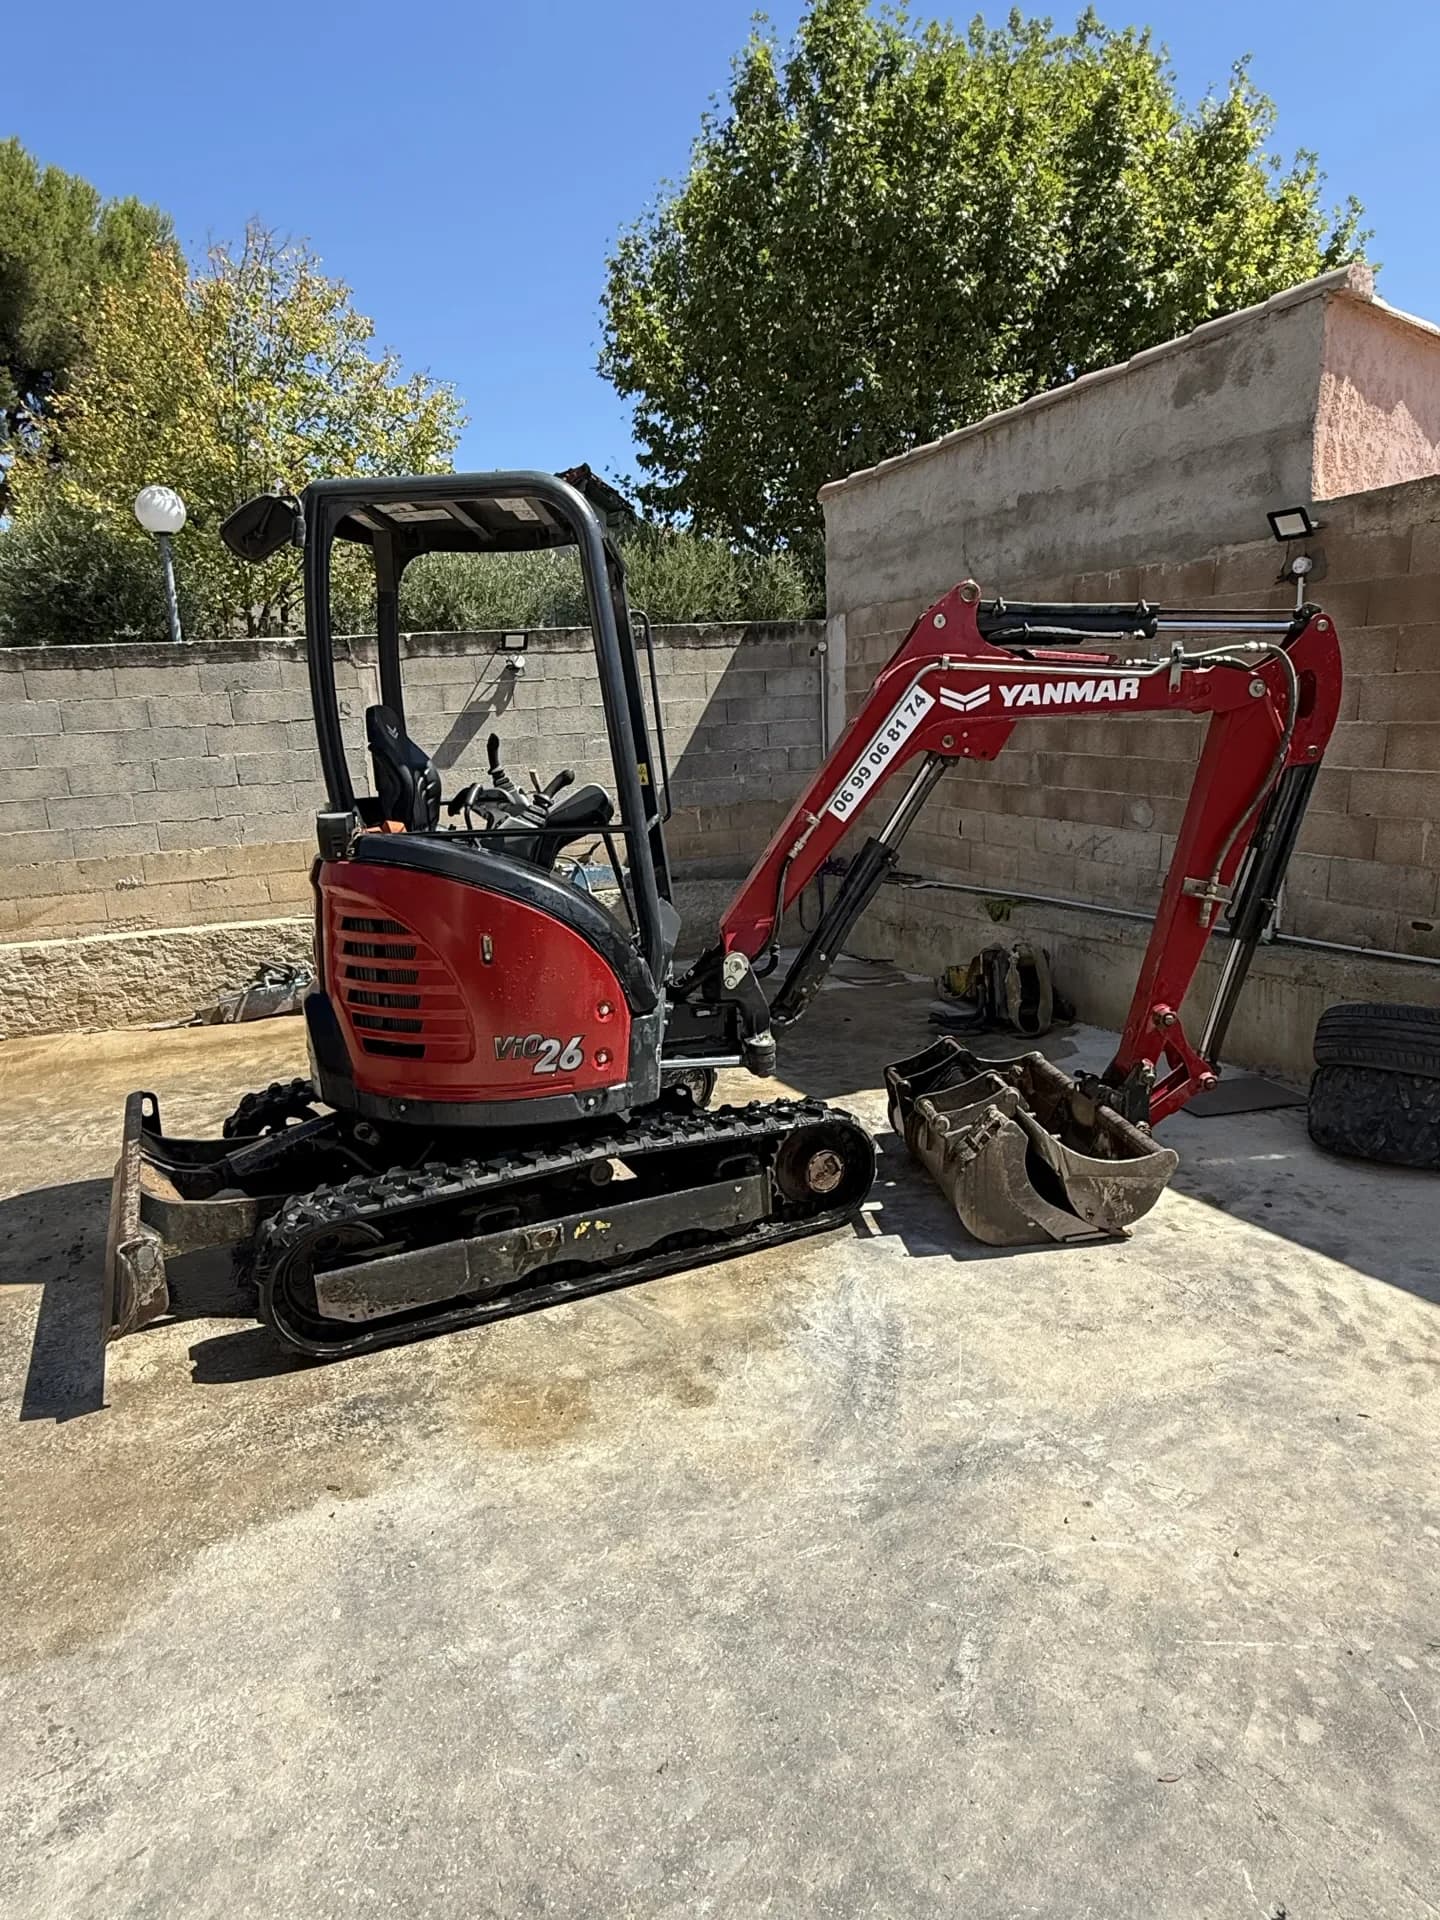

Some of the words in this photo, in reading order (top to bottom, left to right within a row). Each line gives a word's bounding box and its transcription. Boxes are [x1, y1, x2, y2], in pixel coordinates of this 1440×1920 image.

[998, 677, 1140, 707] YANMAR
[833, 789, 855, 813] 06
[850, 766, 872, 789] 99
[869, 742, 890, 765] 06
[886, 718, 907, 742] 81
[903, 694, 926, 717] 74
